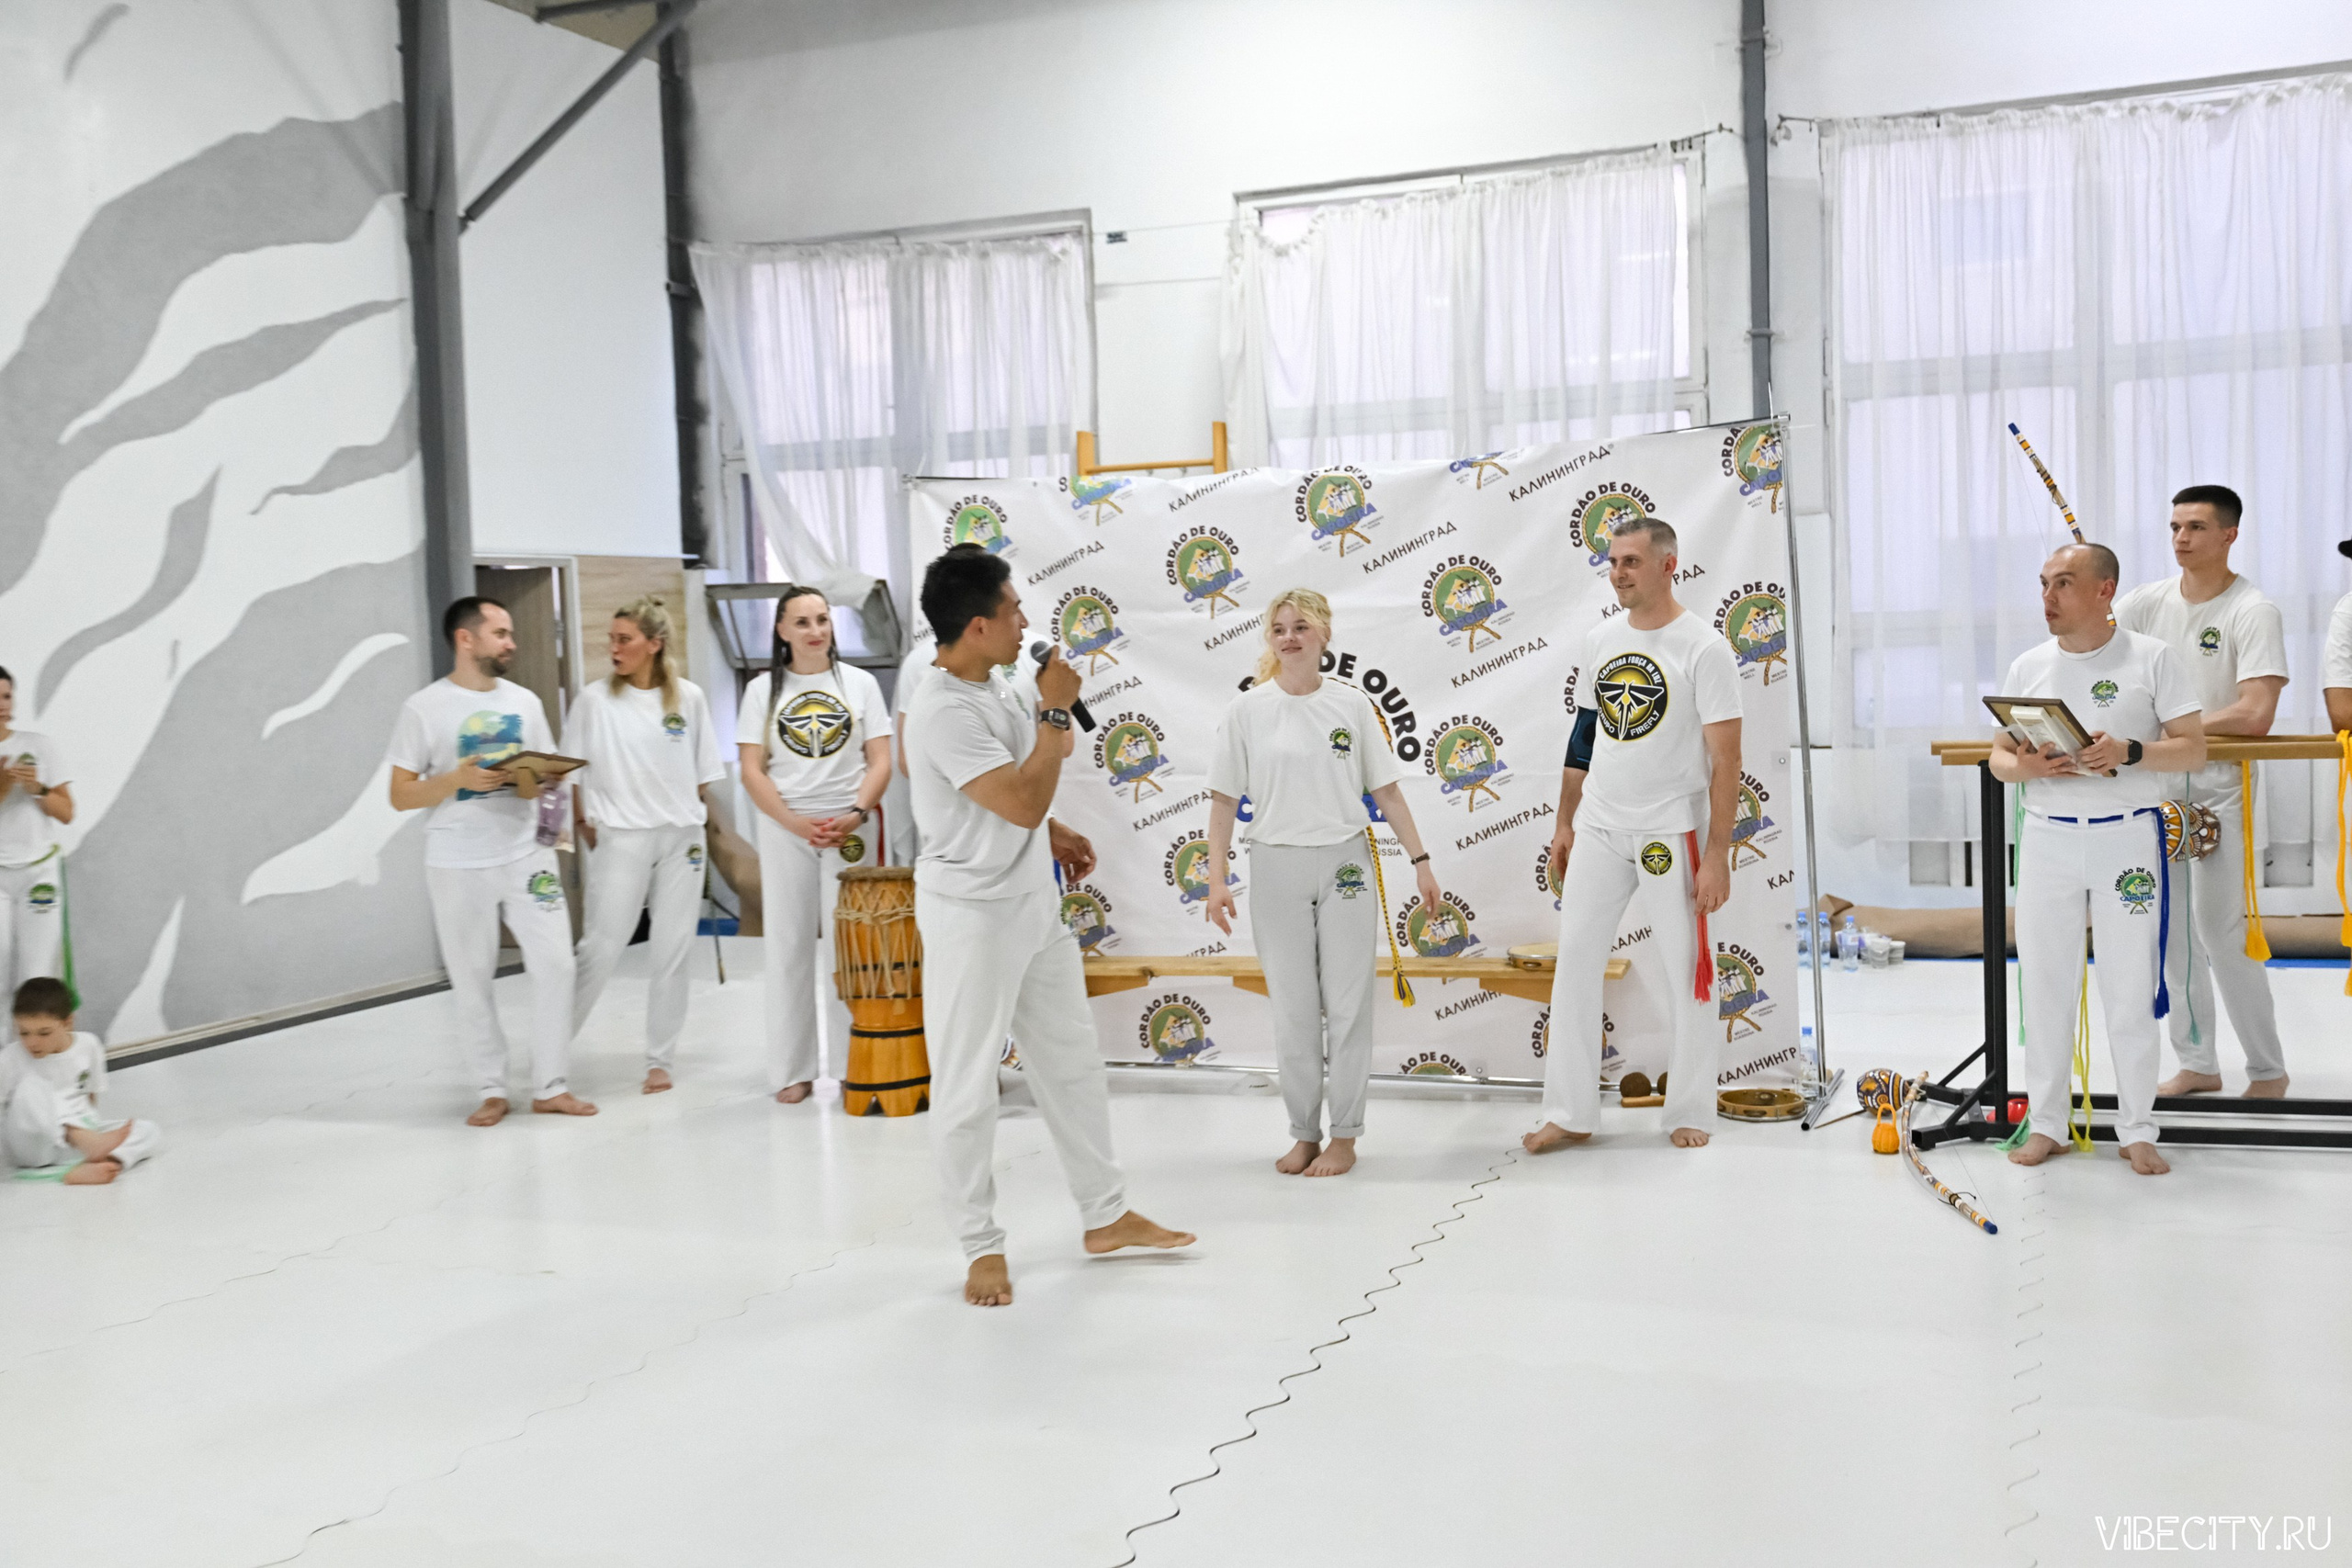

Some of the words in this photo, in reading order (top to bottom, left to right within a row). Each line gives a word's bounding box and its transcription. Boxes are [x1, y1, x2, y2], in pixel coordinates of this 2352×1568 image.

[1168, 466, 1260, 513] КАЛИНИНГРАД
[1508, 445, 1611, 502] КАЛИНИНГРАД
[963, 494, 978, 506] DE
[981, 496, 1008, 524] OURO
[1569, 491, 1597, 548] CORDÃO
[1598, 481, 1617, 494] DE
[1621, 482, 1656, 513] OURO
[1027, 540, 1104, 587] КАЛИНИНГРАД
[1166, 532, 1188, 586] CORDÃO
[1190, 525, 1205, 536] DE
[1209, 526, 1238, 556] OURO
[1363, 521, 1457, 574] КАЛИНИНГРАД
[1421, 561, 1446, 617] CORDÃO
[1448, 554, 1465, 567] DE
[1469, 556, 1502, 586] OURO
[1713, 589, 1741, 635] RDÃO
[1743, 581, 1763, 594] DE
[1051, 592, 1072, 642] CORDÃO
[1073, 585, 1088, 596] DE
[1090, 587, 1118, 615] OURO
[1439, 598, 1508, 637] CAPOEIRA
[1451, 637, 1548, 688] КАЛИНИНГРАД
[1599, 657, 1626, 679] CAPOEIRA
[1645, 662, 1655, 673] DA
[1651, 671, 1662, 684] LUZ
[1318, 649, 1357, 679] DE
[1363, 669, 1421, 762] OURO
[1599, 706, 1615, 733] GRUPO
[1631, 710, 1659, 736] FIREFLY
[1093, 717, 1117, 769] CORDÃO
[1119, 712, 1134, 723] DE
[1136, 713, 1165, 742] OURO
[1424, 720, 1450, 776] CORDÃO
[1452, 715, 1468, 727] DE
[1472, 716, 1503, 747] OURO
[1441, 759, 1508, 795] CAPOEIRA
[1455, 802, 1555, 851] КАЛИНИНГРАД
[1164, 834, 1186, 886] CORDÃO
[1189, 829, 1204, 840] DE
[1066, 883, 1080, 893] DE
[1084, 884, 1112, 913] OURO
[1396, 896, 1420, 947] CORDÃO
[1443, 891, 1476, 921] OURO
[1729, 943, 1764, 976] OURO
[1139, 998, 1162, 1049] CORDÃO
[1163, 993, 1179, 1004] DE
[1182, 996, 1211, 1025] OURO
[1532, 1006, 1551, 1058] CORDÃ
[1419, 1052, 1436, 1063] DE
